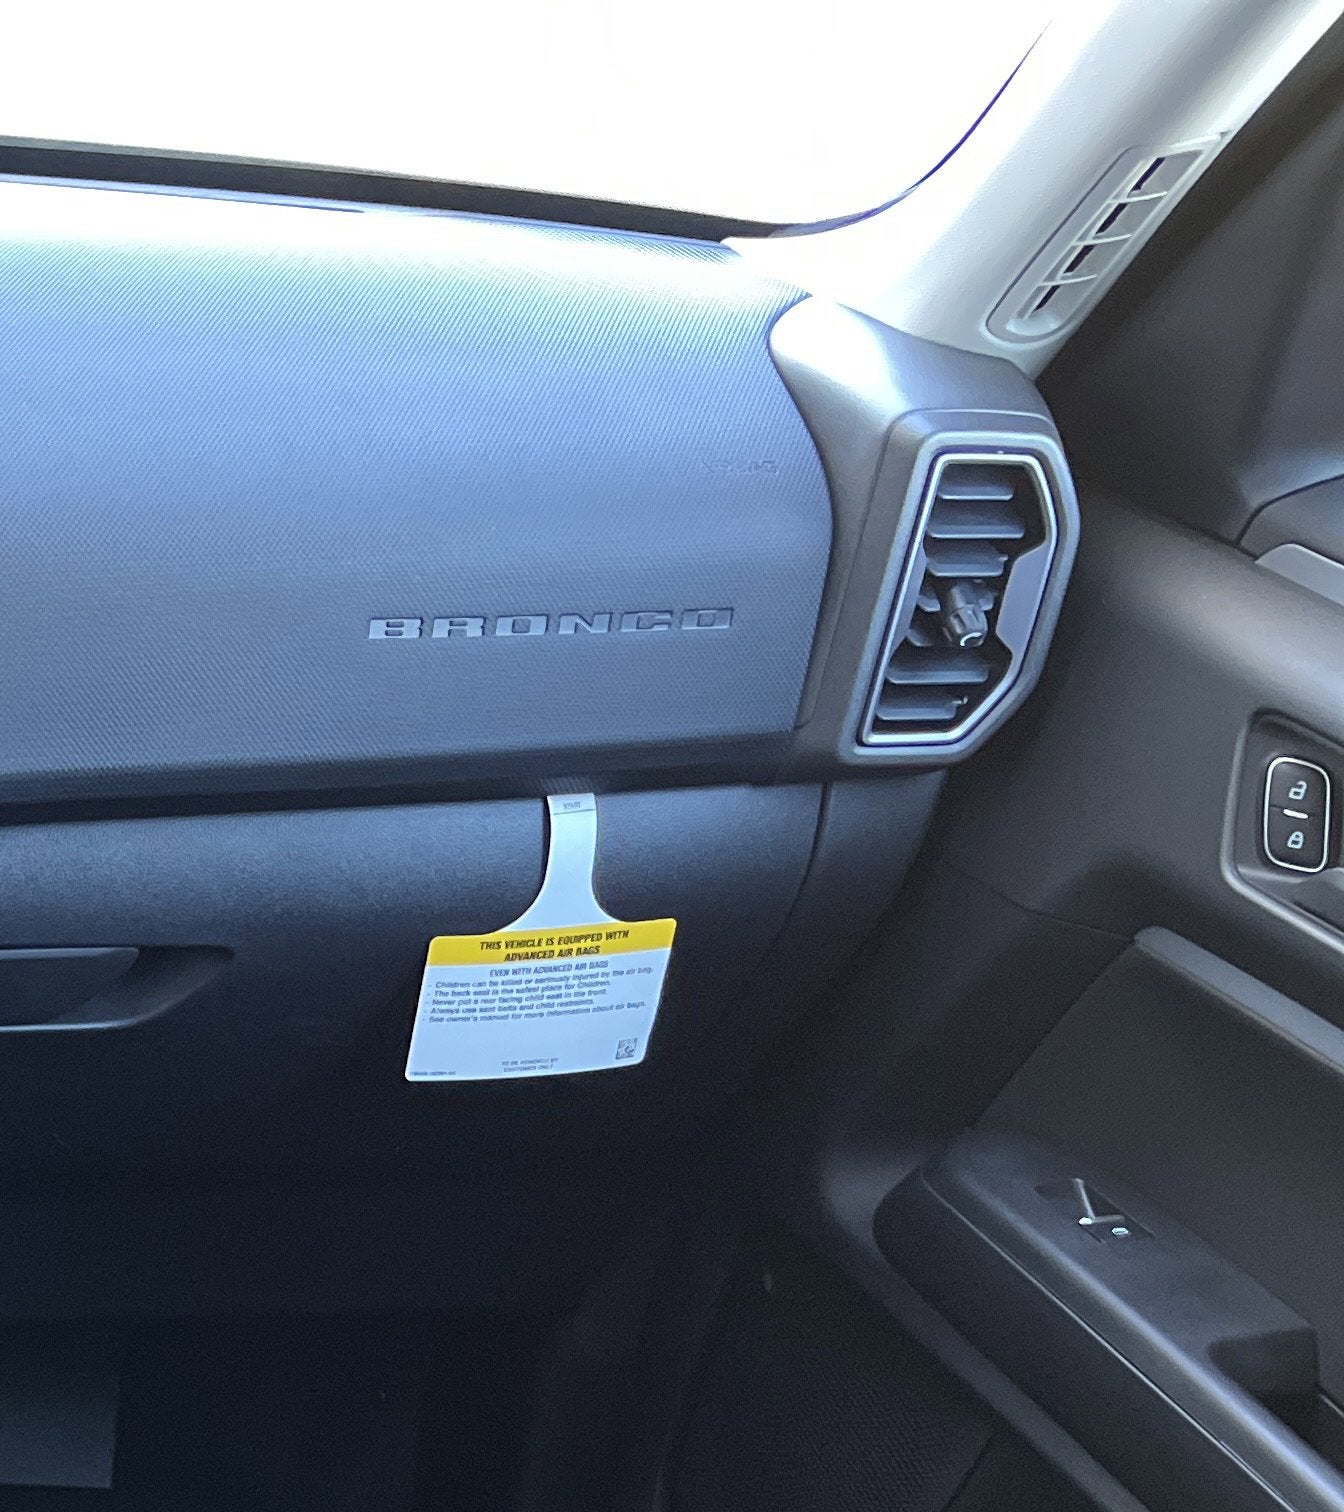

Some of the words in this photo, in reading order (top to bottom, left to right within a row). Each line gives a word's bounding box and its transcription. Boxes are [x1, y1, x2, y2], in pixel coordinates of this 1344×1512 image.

[368, 608, 733, 639] BRONCO
[480, 941, 502, 950] THIS
[505, 938, 543, 949] VEHICLE
[546, 937, 554, 946] IS
[557, 932, 602, 945] EQUIPPED
[606, 930, 630, 941] WITH
[504, 949, 555, 961] ADVANCED
[557, 948, 573, 958] AIR
[575, 946, 600, 956] BAGS
